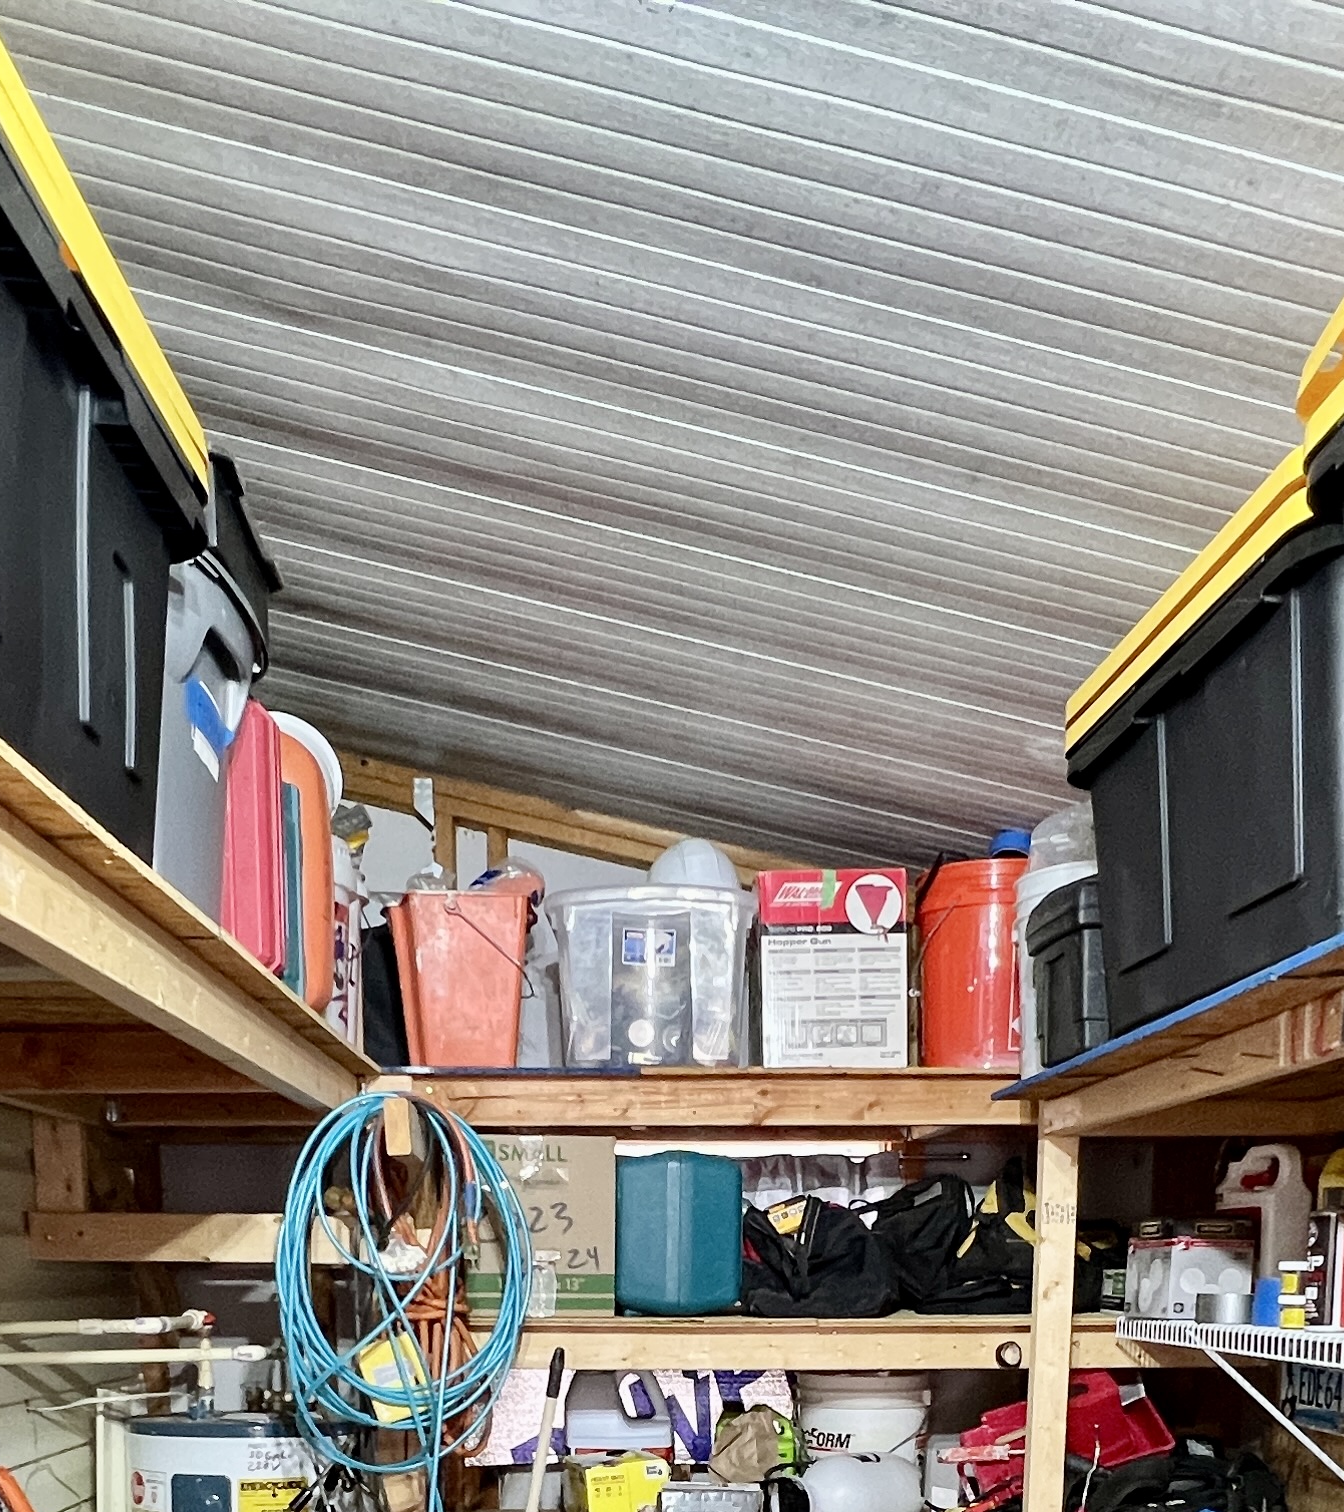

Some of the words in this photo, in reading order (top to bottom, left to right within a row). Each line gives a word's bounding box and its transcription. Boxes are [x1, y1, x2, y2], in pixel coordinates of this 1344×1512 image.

[768, 938, 808, 947] Hopper
[810, 937, 832, 945] Gun
[498, 1144, 568, 1162] SMLL
[566, 1245, 599, 1270] 24
